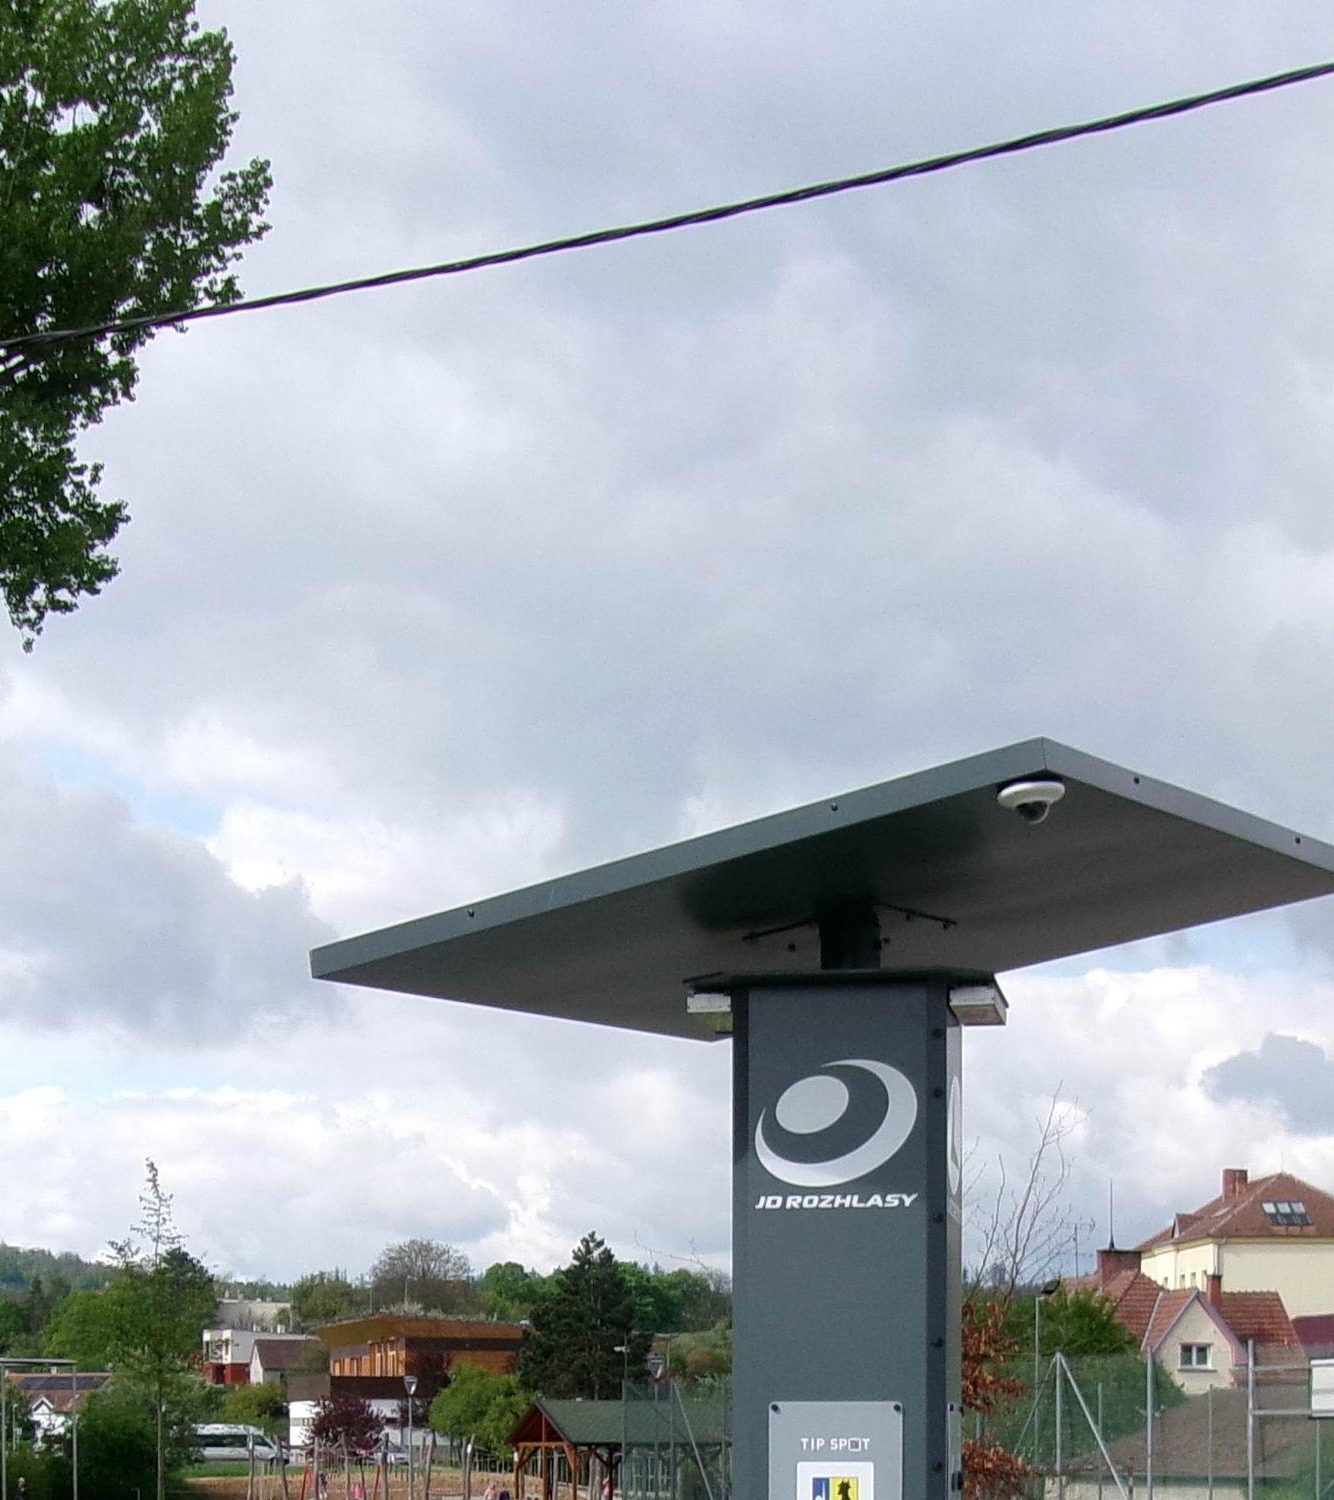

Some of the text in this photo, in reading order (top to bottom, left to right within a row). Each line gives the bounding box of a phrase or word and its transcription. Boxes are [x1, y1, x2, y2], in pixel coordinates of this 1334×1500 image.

[754, 1192, 919, 1210] JD ROZHLASY
[800, 1437, 826, 1452] TIP
